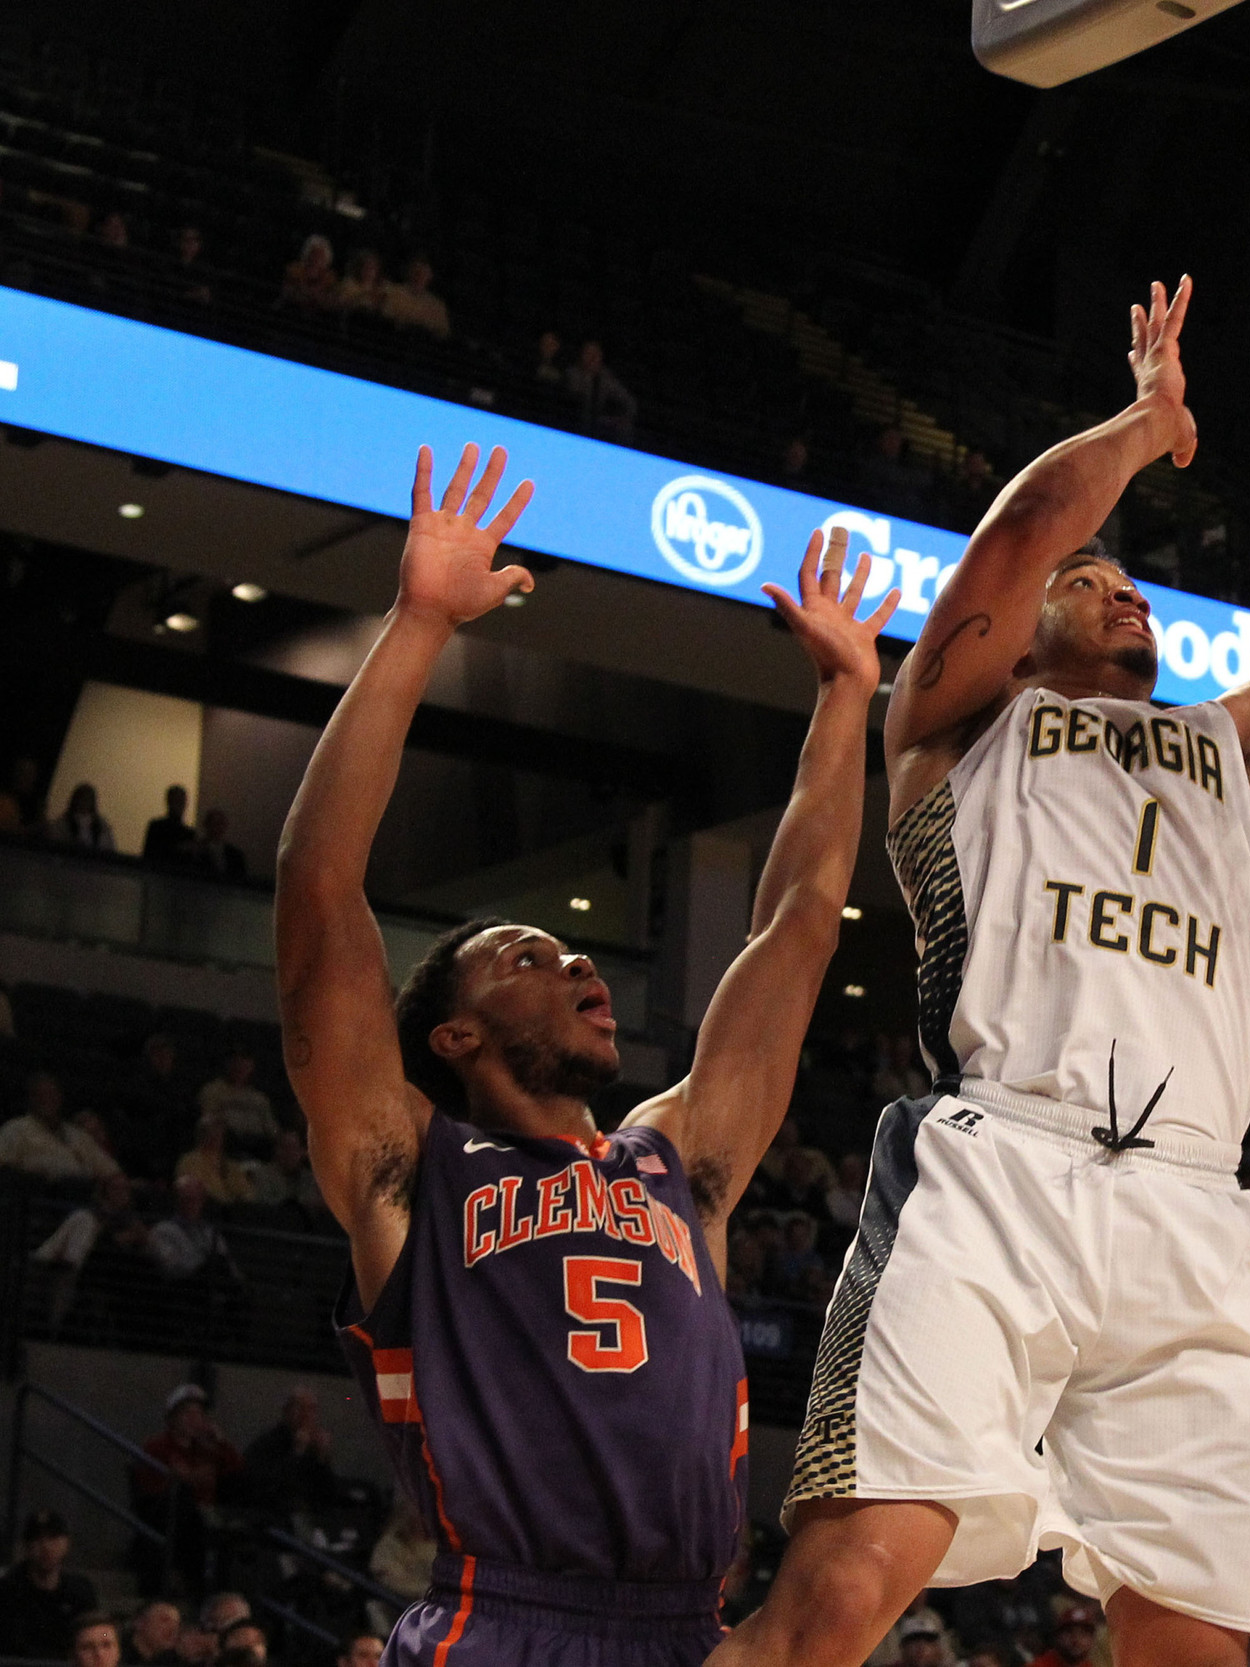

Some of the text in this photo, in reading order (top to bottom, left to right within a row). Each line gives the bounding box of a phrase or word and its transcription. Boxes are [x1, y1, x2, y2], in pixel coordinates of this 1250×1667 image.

[666, 492, 750, 570] Kroger
[1029, 704, 1224, 804] GEORGIA
[1132, 798, 1160, 877] 1
[1044, 879, 1222, 990] TECH
[937, 1118, 979, 1138] RUSSELL
[464, 1160, 702, 1298] CLEMSON
[562, 1255, 649, 1374] 5
